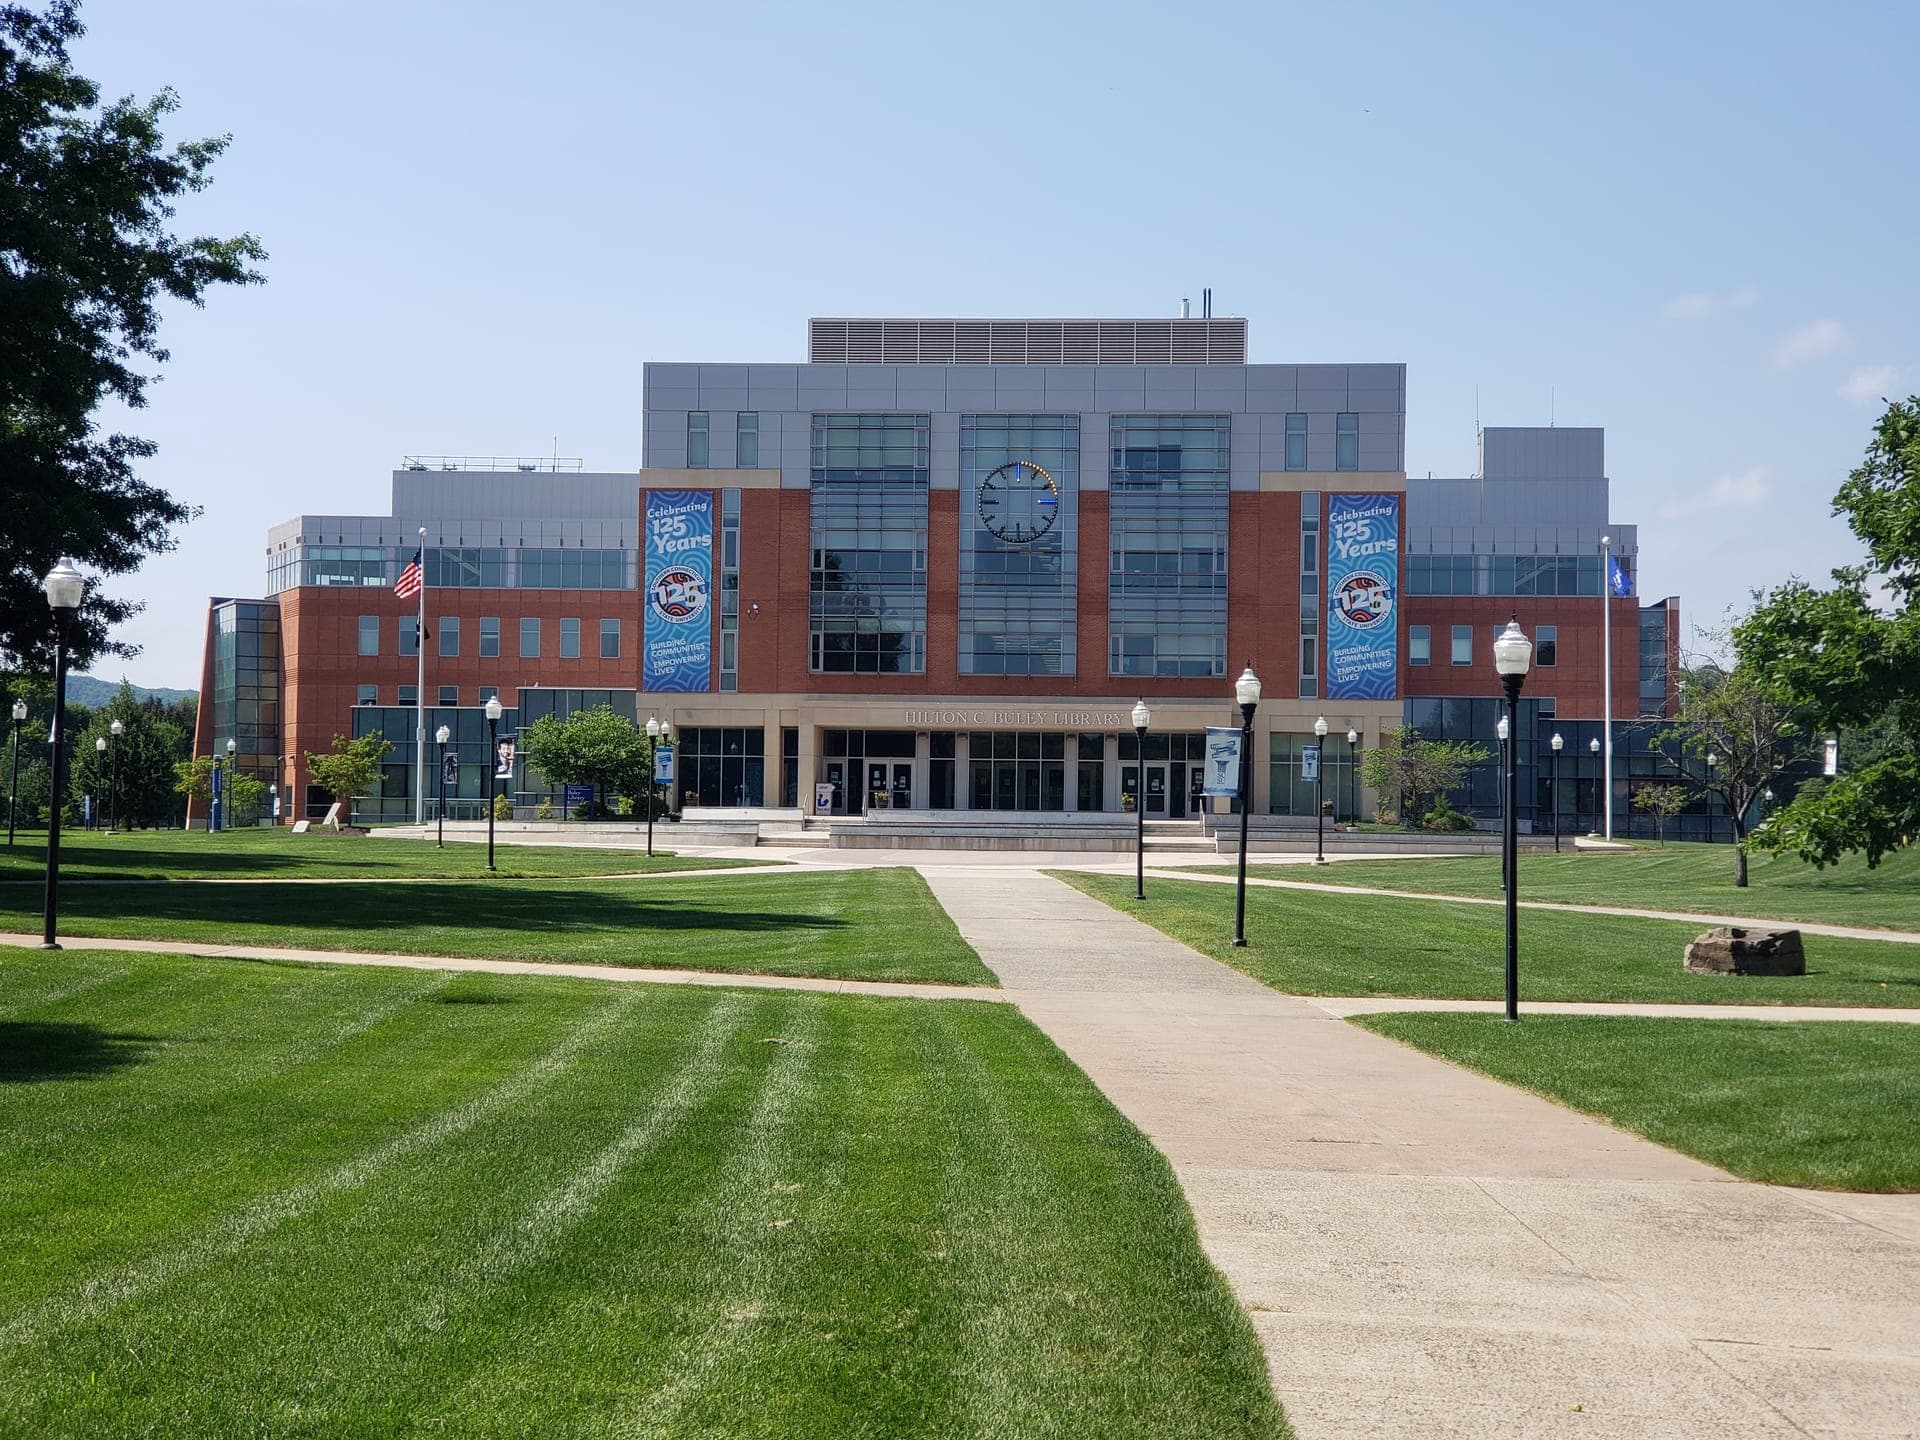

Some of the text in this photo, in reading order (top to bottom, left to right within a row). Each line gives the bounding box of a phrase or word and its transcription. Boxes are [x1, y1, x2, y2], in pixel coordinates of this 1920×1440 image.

[647, 502, 707, 518] Celebrating
[1330, 506, 1392, 522] Celebrating
[652, 515, 687, 537] 125
[1335, 519, 1371, 541] 125
[652, 533, 712, 554] Years
[1335, 538, 1396, 559] Years
[671, 566, 704, 583] CONNECTICUT
[656, 580, 706, 608] 125
[1340, 585, 1391, 614] 125
[659, 604, 703, 622] STATE UNIVERSITY
[1342, 609, 1388, 628] STATE UNIVERSITY
[651, 639, 686, 651] BUILDING
[651, 642, 705, 658] COMMUNITIES
[1334, 645, 1371, 657] BUILDING
[653, 653, 706, 669] EMPOWERING
[1335, 648, 1391, 664] COMMUNITIES
[654, 666, 676, 676] LIVES
[1336, 660, 1392, 676] EMPOWERING
[1337, 673, 1360, 683] LIVES
[905, 711, 1125, 726] HILTON C. BULEY LIBRARY
